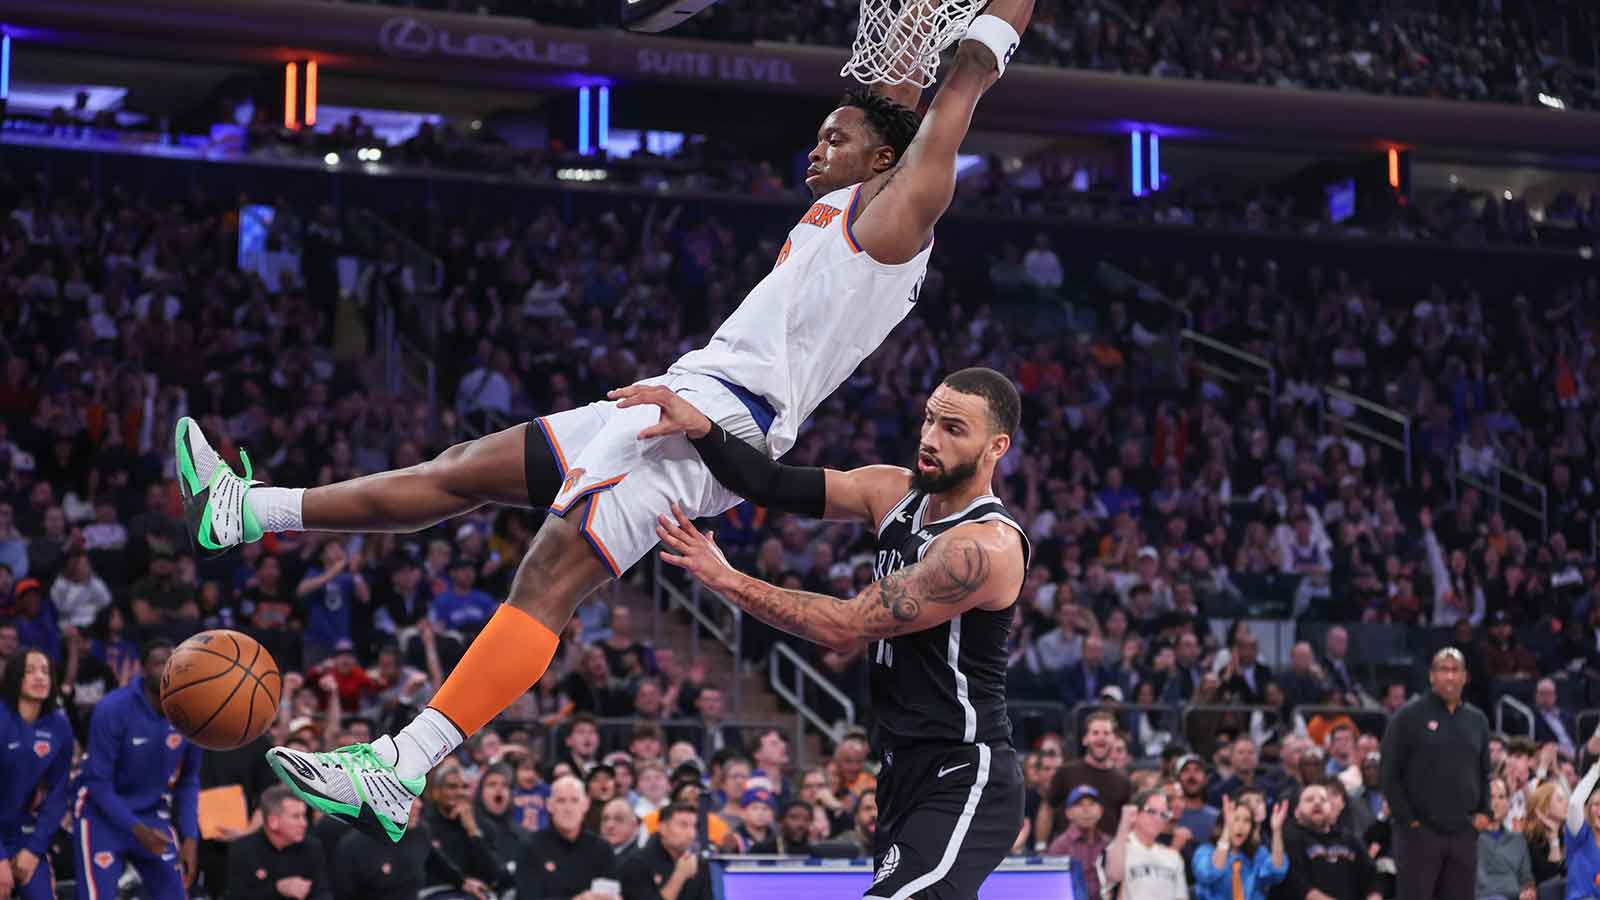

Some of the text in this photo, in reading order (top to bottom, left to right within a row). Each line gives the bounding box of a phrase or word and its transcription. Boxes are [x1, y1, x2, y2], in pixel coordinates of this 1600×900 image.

[440, 33, 589, 65] LEXUS
[638, 48, 797, 83] SUITE LEVEL
